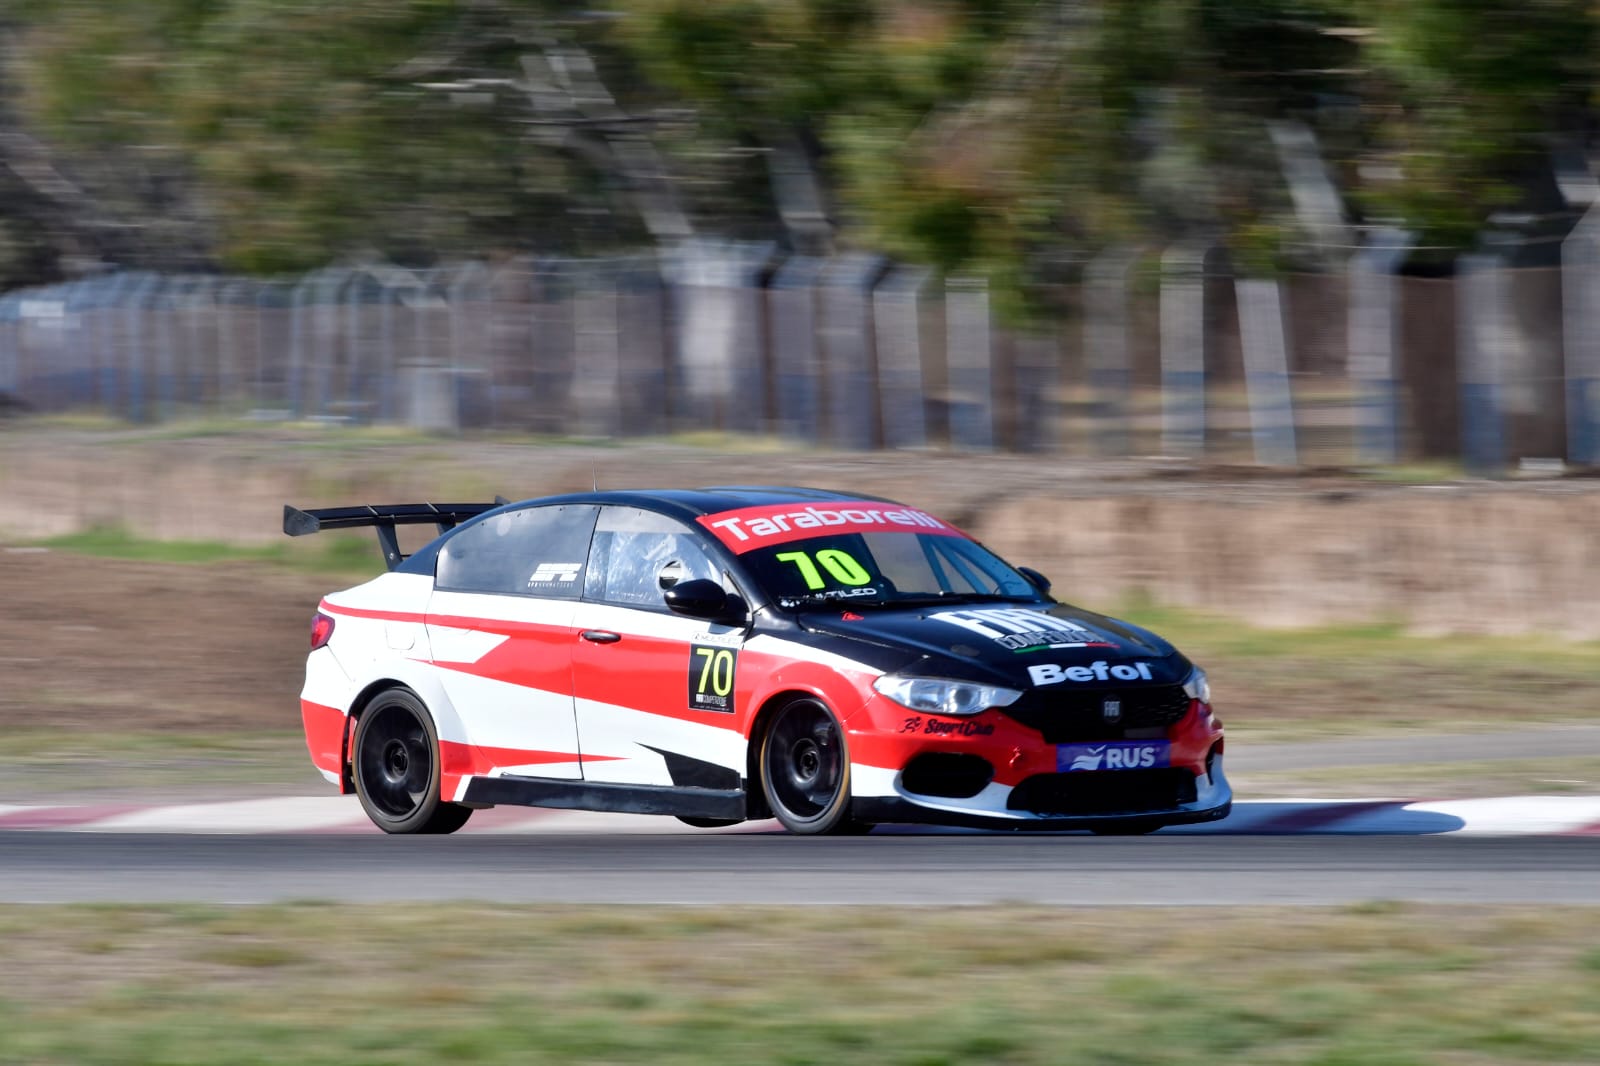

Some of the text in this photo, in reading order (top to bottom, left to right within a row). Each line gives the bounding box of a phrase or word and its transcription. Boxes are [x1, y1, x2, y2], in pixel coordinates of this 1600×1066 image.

[711, 507, 946, 541] Taraborelli
[776, 549, 871, 590] 70
[928, 608, 1088, 639] FIAT
[696, 647, 733, 697] 70
[1027, 660, 1153, 686] Befol
[1106, 747, 1155, 768] RUS
